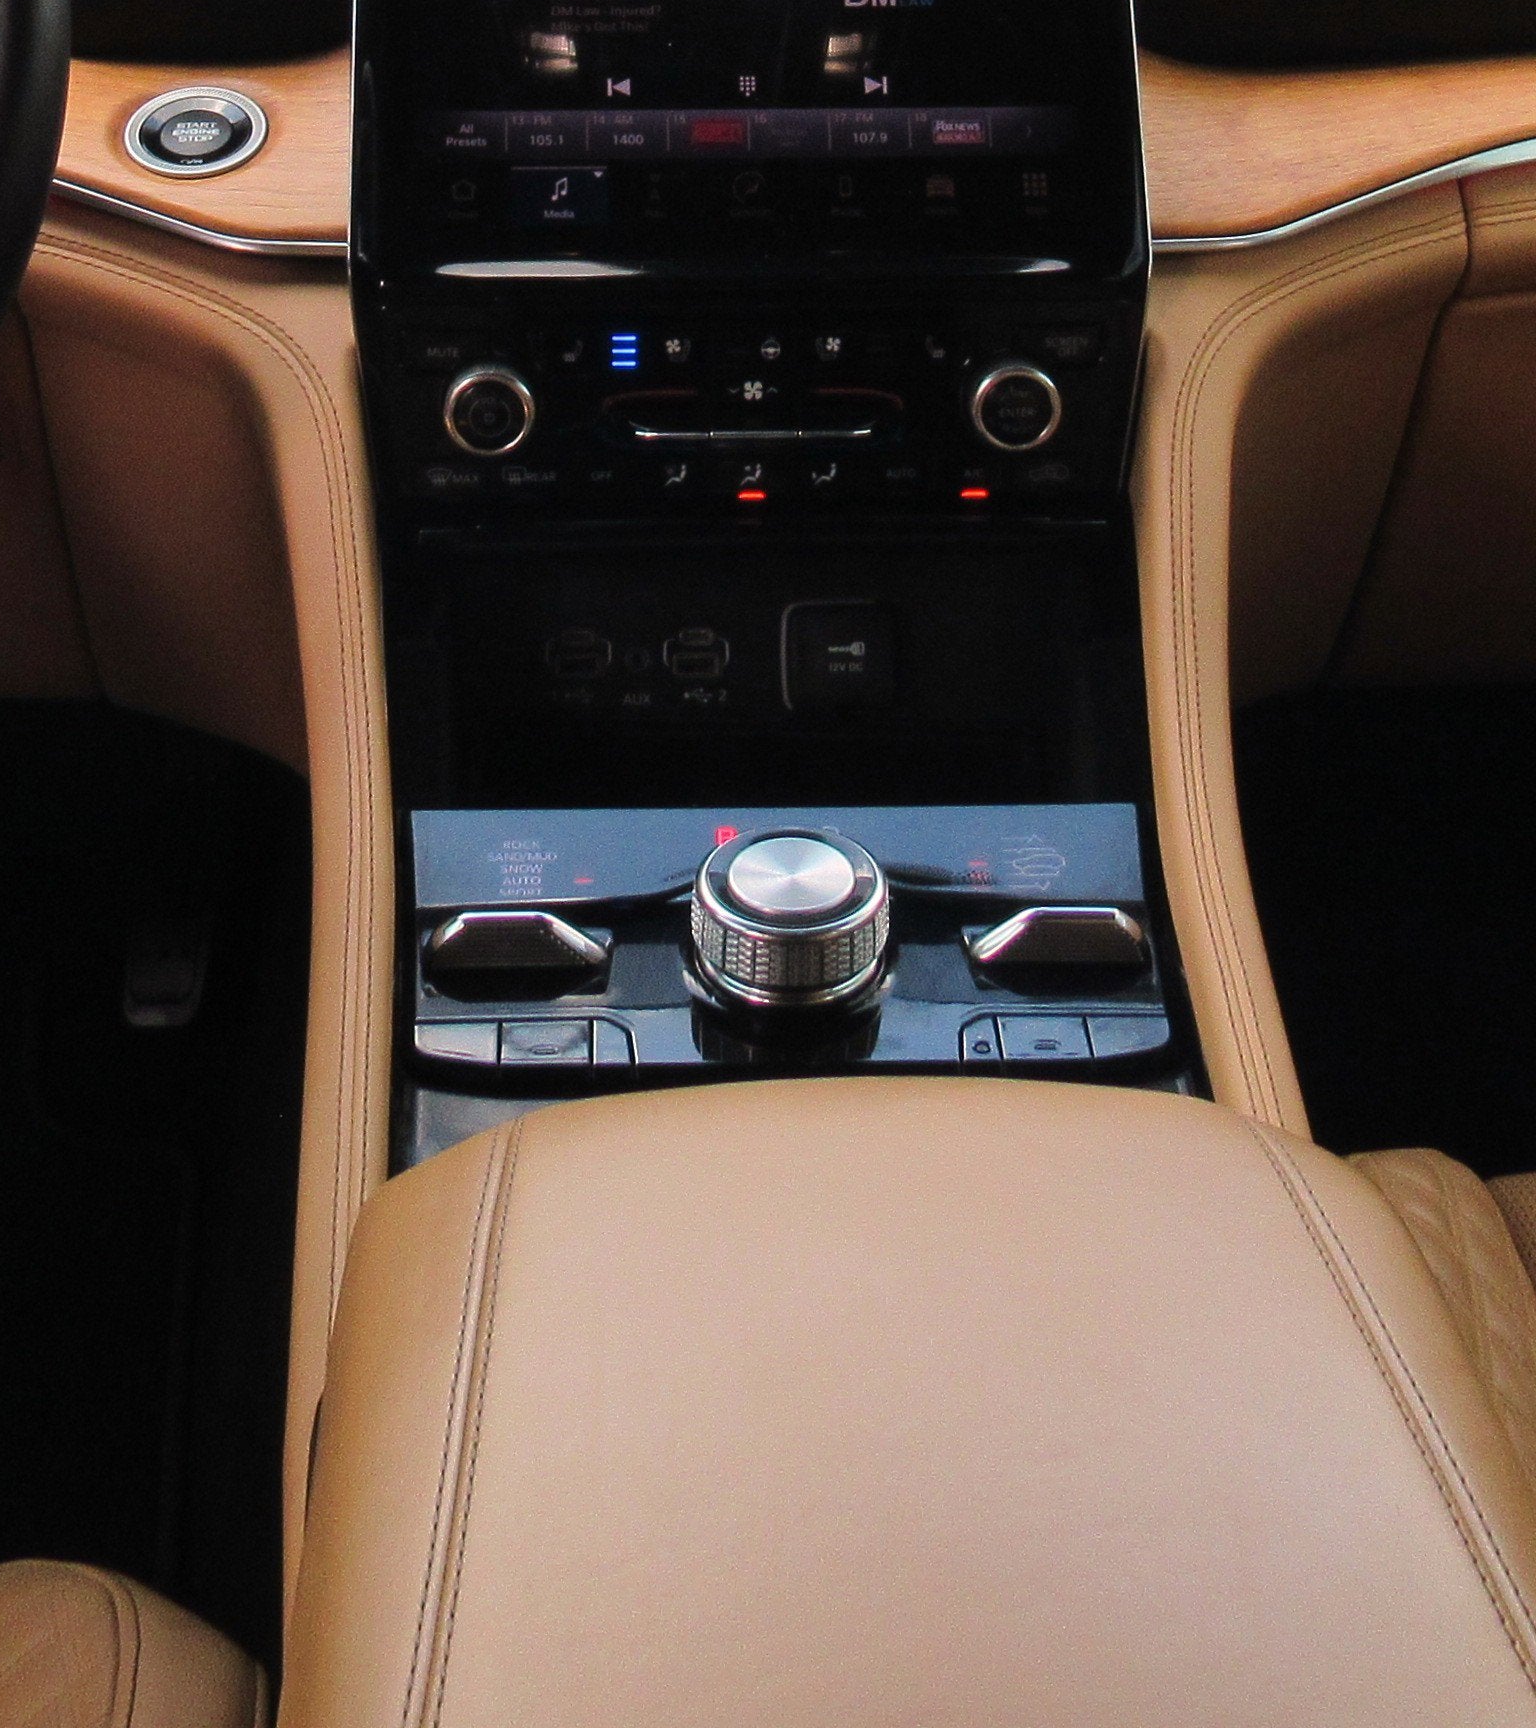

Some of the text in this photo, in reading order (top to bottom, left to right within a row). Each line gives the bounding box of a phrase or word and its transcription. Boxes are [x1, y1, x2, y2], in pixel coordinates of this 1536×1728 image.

[459, 122, 474, 134] All
[178, 135, 213, 143] STOP
[445, 134, 488, 147] Presets
[529, 134, 566, 147] 105.1
[611, 134, 646, 147] 1400
[851, 131, 889, 145] 107.9
[426, 346, 461, 359] MUTE
[589, 470, 613, 482] OFF
[885, 467, 917, 479] AUTO
[828, 662, 847, 673] 12V
[621, 694, 652, 708] AUX
[502, 876, 542, 886] AUTO
